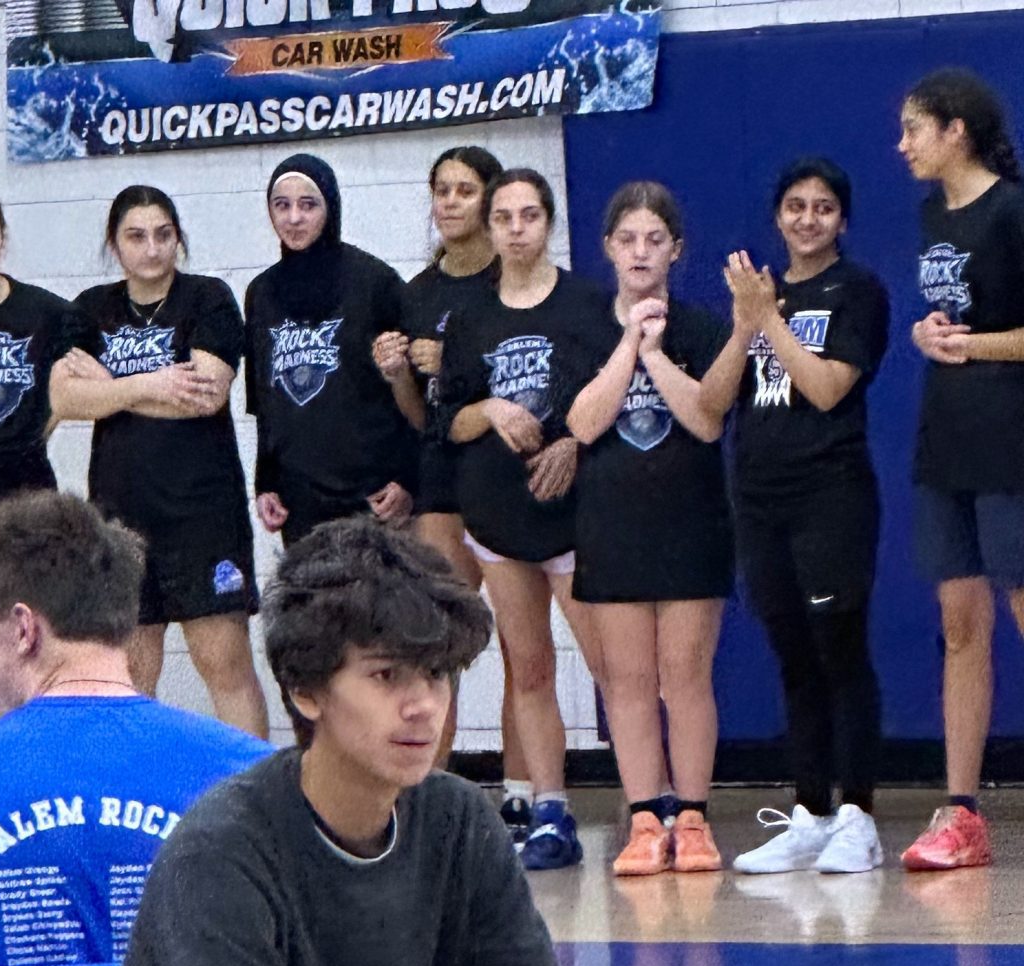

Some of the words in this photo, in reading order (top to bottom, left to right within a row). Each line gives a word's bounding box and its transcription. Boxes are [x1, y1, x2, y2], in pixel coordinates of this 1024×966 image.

[272, 41, 323, 67] CAR
[332, 34, 402, 63] WASH
[100, 68, 566, 146] QUICKPASSCARWASH.COM
[107, 332, 170, 362] ROCK
[276, 325, 334, 357] ROCK
[495, 348, 553, 382] ROCK
